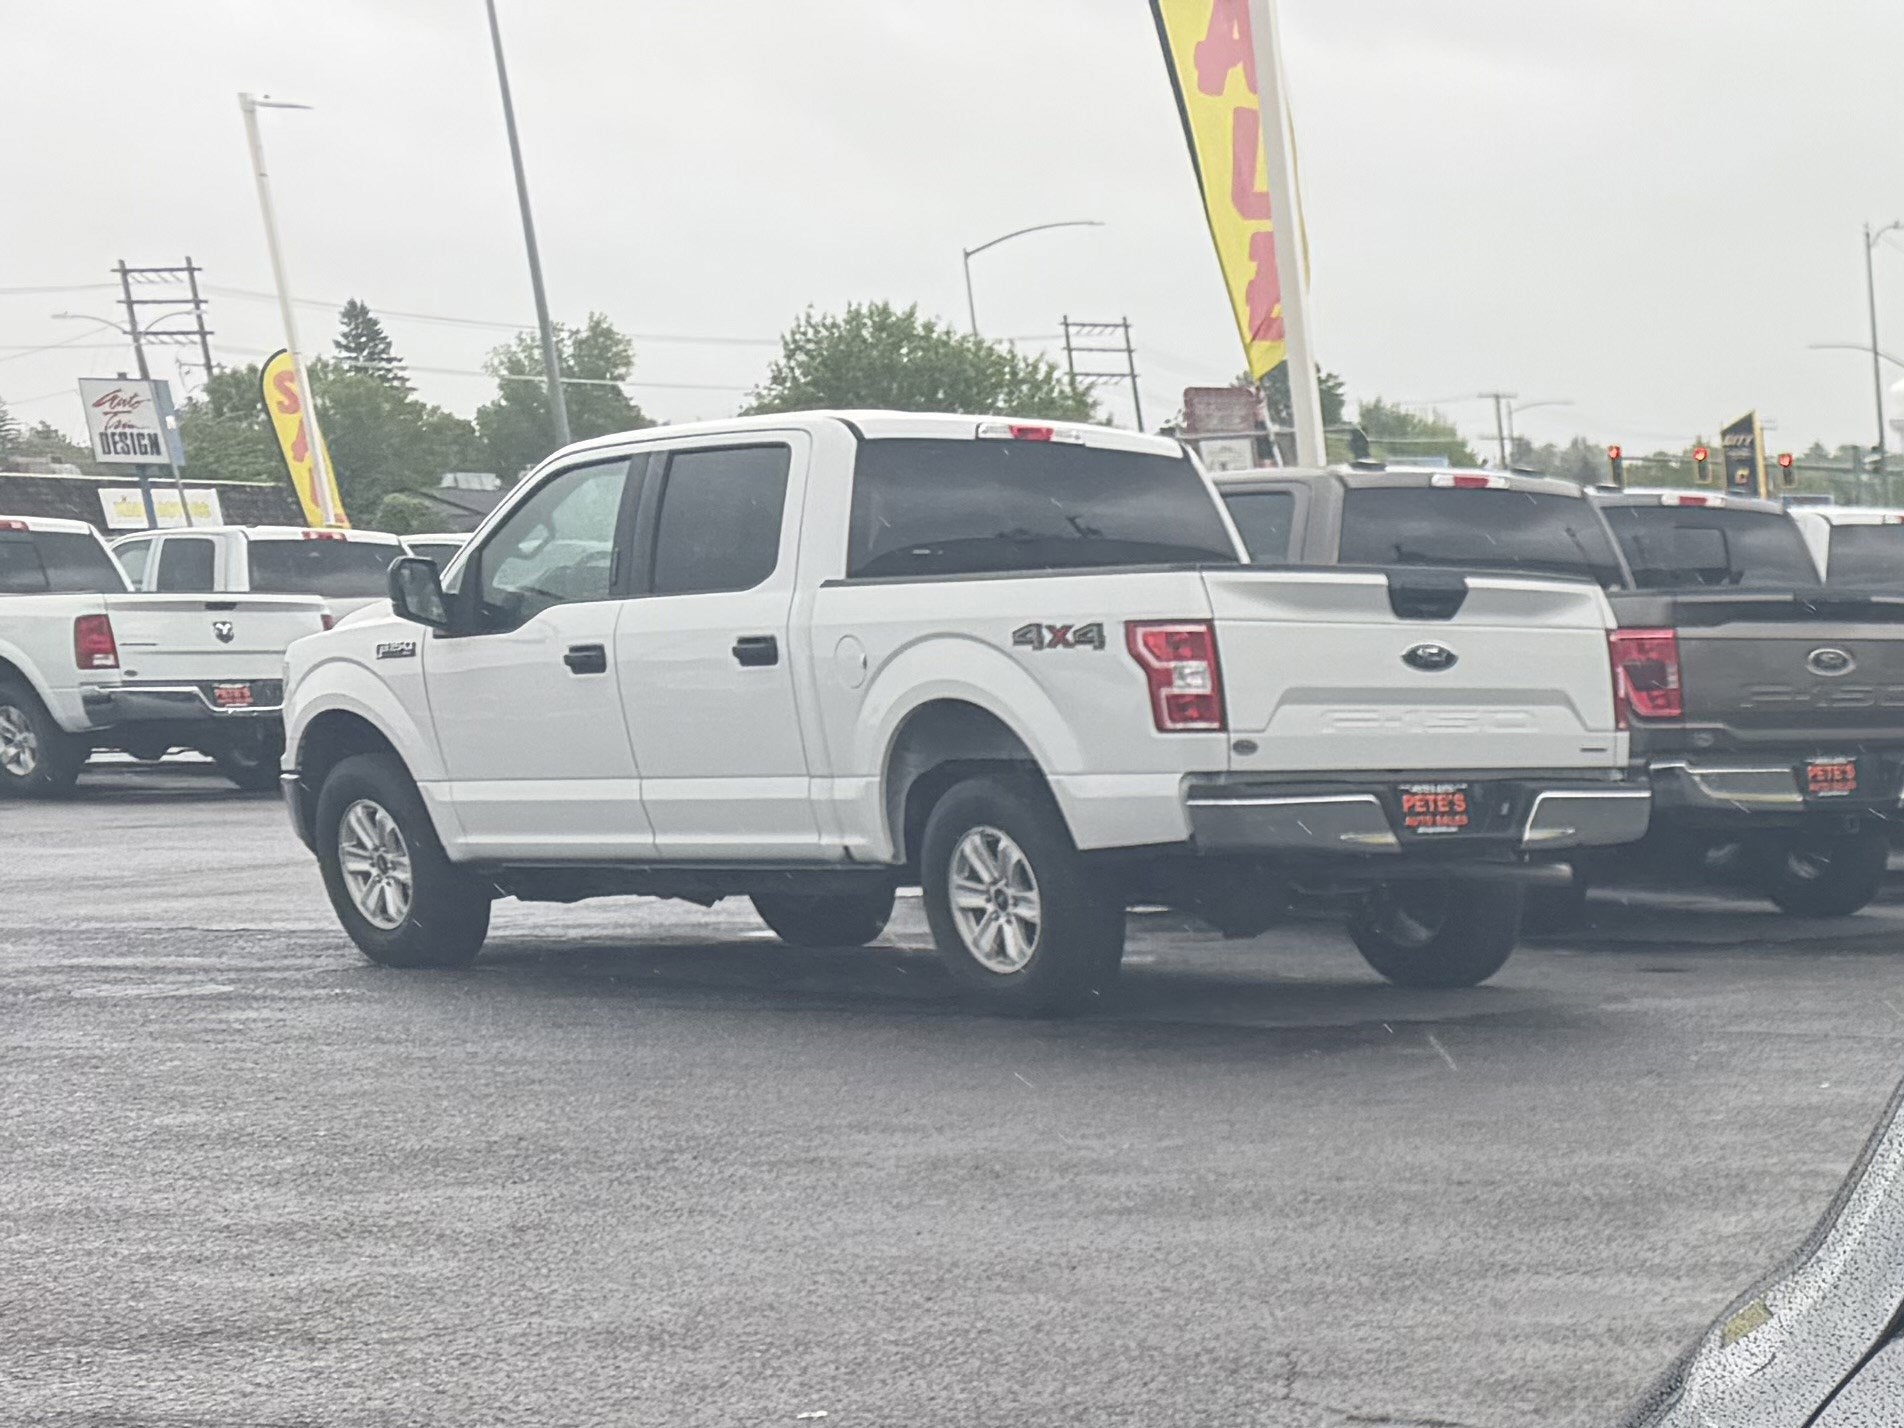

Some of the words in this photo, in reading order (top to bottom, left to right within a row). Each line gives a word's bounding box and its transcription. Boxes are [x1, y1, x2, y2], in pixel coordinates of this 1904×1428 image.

[92, 388, 150, 409] Auto
[98, 431, 162, 456] DESIGN
[1402, 792, 1467, 813] PETE'S
